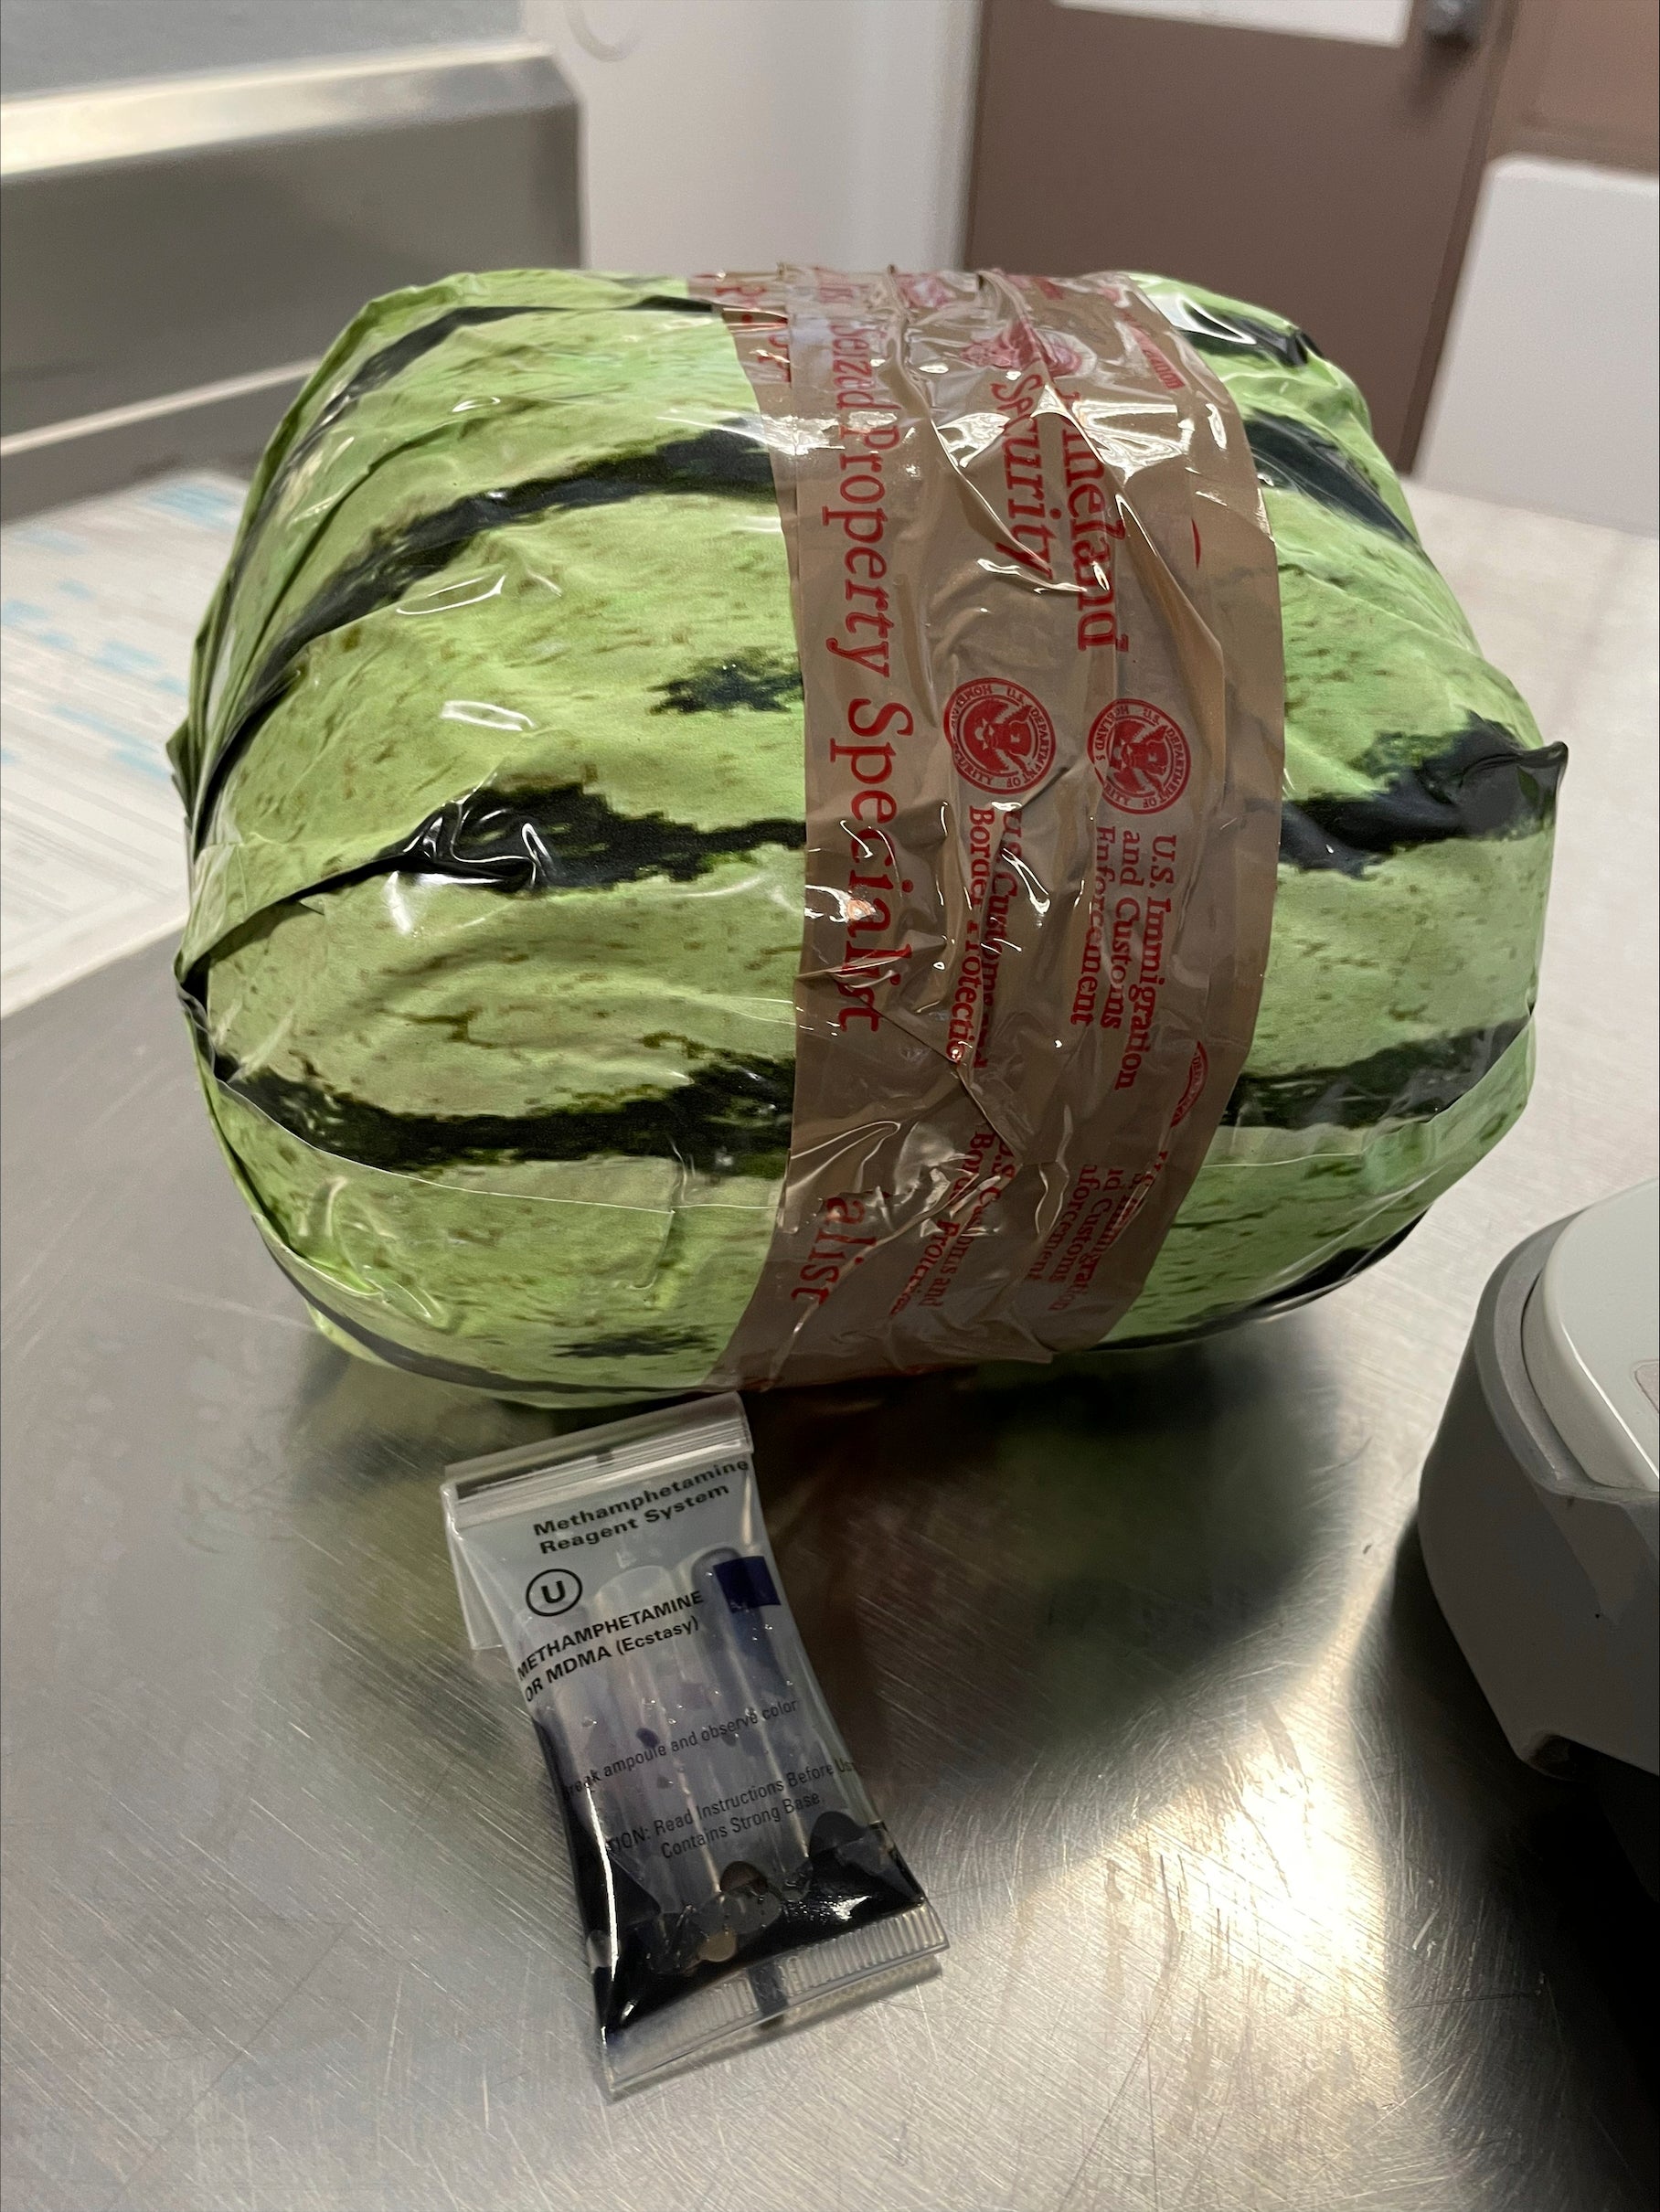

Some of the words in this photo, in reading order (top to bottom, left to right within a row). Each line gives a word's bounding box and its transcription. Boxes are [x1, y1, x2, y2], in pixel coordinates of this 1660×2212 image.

[823, 424, 902, 678] Property
[1054, 388, 1129, 651] meland
[830, 698, 913, 1032] Specialist
[1121, 831, 1144, 886] and
[1150, 835, 1176, 888] U.S.
[1070, 826, 1116, 1026] Enforcement
[1101, 898, 1140, 1028] Customs
[1115, 898, 1171, 1090] Immigration
[792, 1197, 877, 1306] alist
[1027, 1164, 1099, 1281] nforcement
[1048, 1198, 1112, 1282] Customs
[533, 1461, 750, 1536] Methamphetamine
[539, 1518, 639, 1554] Reagent
[644, 1485, 729, 1523] System
[541, 1580, 567, 1603] U
[516, 1590, 705, 1681] METHAMPHETAMINE
[525, 1677, 543, 1702] OR
[546, 1646, 612, 1683] MDMA
[616, 1615, 698, 1655] (Ecstasy)
[603, 1744, 666, 1777] ampoule
[671, 1731, 698, 1752] and
[701, 1712, 759, 1741] observe
[761, 1699, 798, 1721] color
[654, 1812, 693, 1837] Read
[697, 1781, 784, 1821] Instructions
[787, 1763, 834, 1788] Before
[834, 1757, 855, 1773] Us
[661, 1826, 728, 1859] Contains
[730, 1804, 781, 1834] Strong
[784, 1792, 821, 1816] Base
